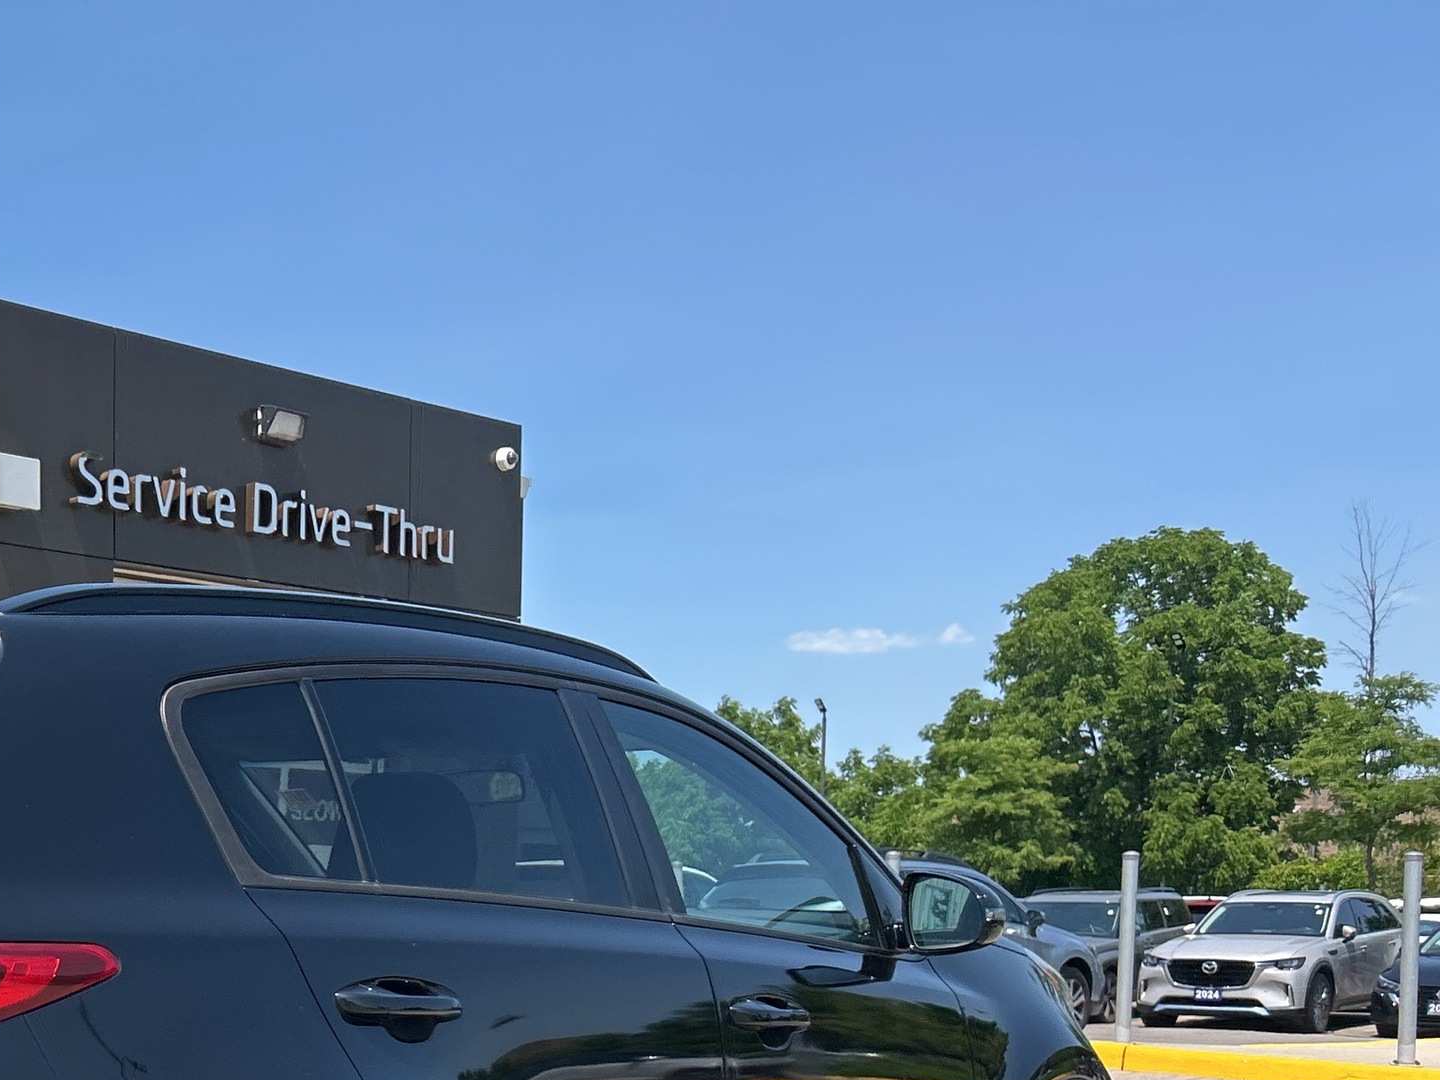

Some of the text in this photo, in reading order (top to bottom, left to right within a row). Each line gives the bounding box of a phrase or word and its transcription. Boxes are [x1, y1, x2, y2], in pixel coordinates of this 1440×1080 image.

[72, 453, 454, 564] Service Drive-Thru
[1195, 989, 1220, 999] 2024
